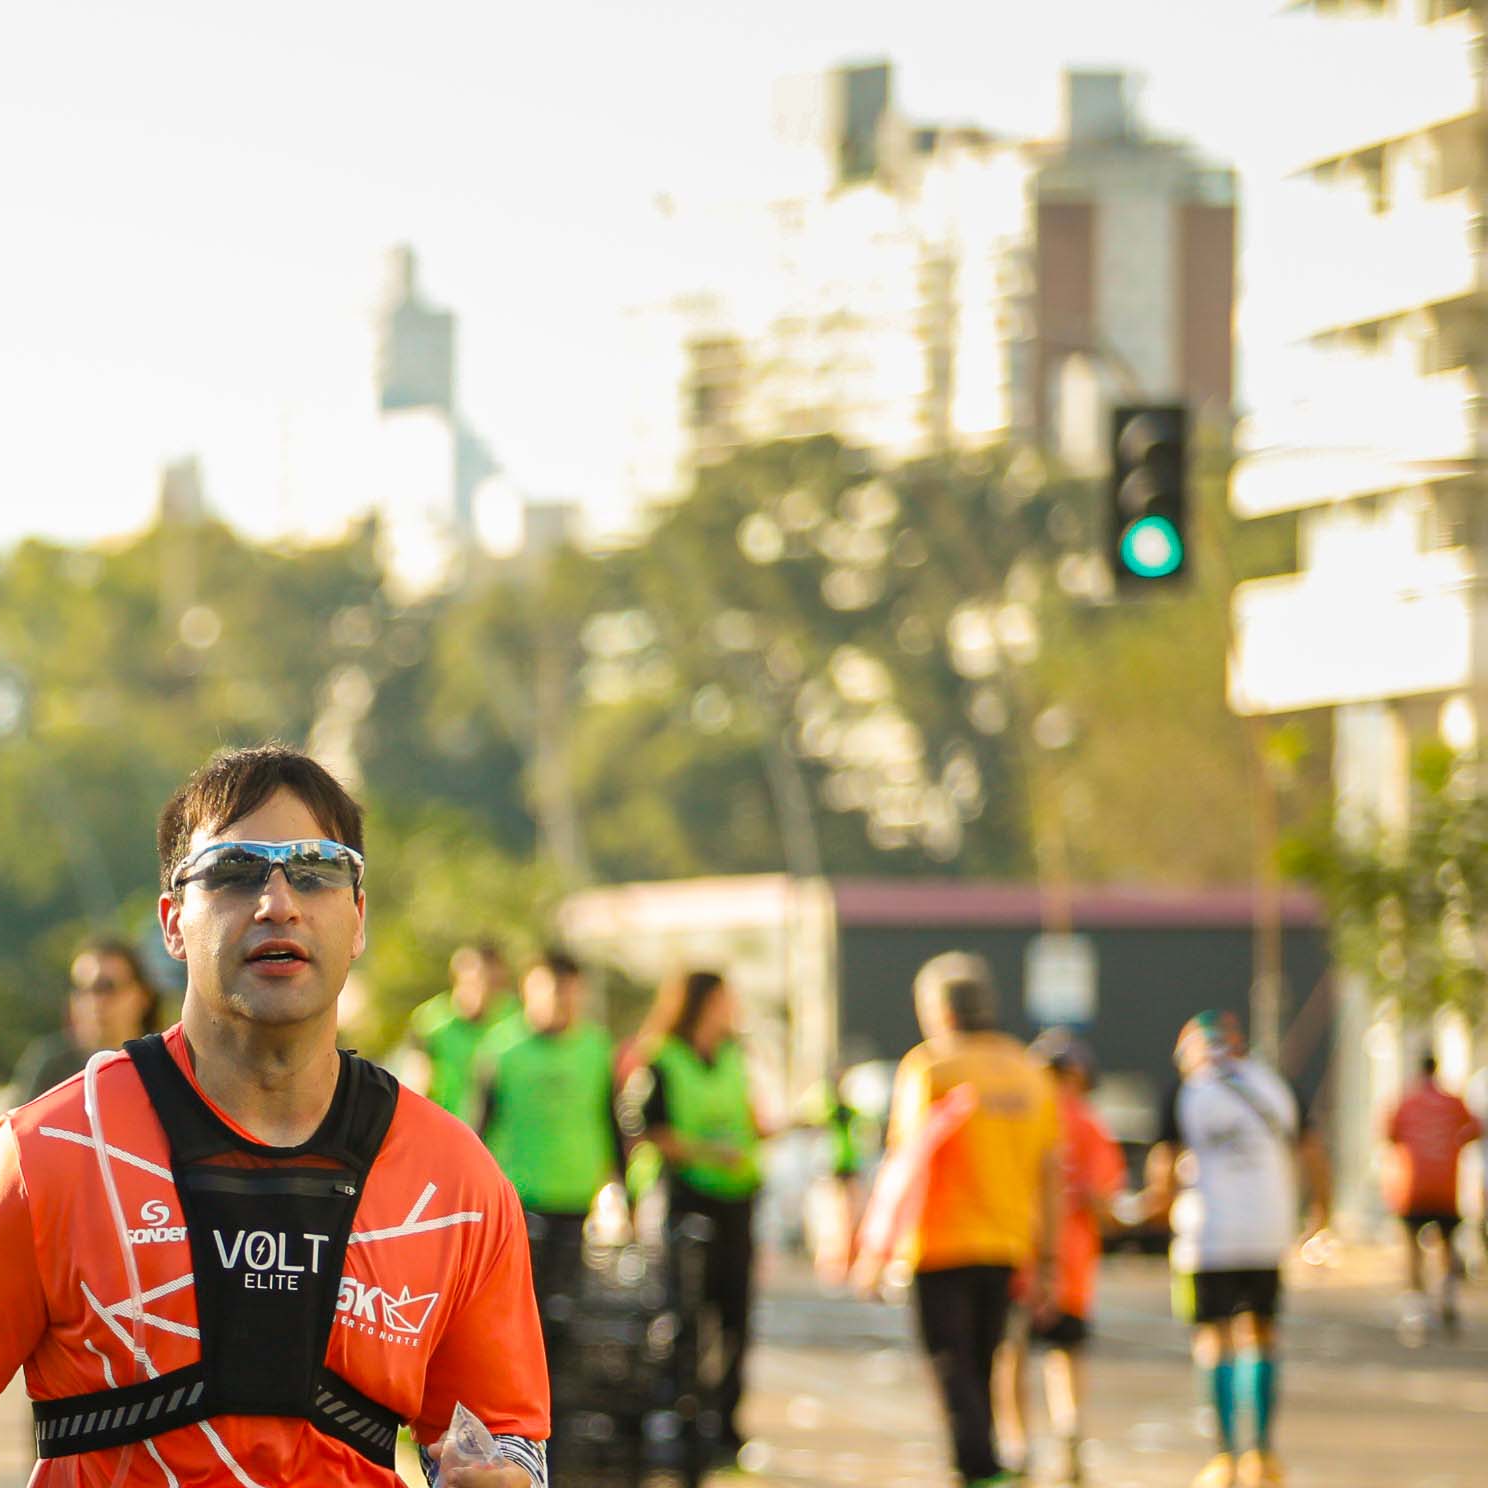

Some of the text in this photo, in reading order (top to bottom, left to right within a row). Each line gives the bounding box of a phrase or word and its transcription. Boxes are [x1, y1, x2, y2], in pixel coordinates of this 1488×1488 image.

[212, 1230, 329, 1274] VOLT
[244, 1273, 299, 1291] ELITE
[336, 1276, 382, 1323] 5K
[340, 1315, 420, 1347] ERTO NORTE
